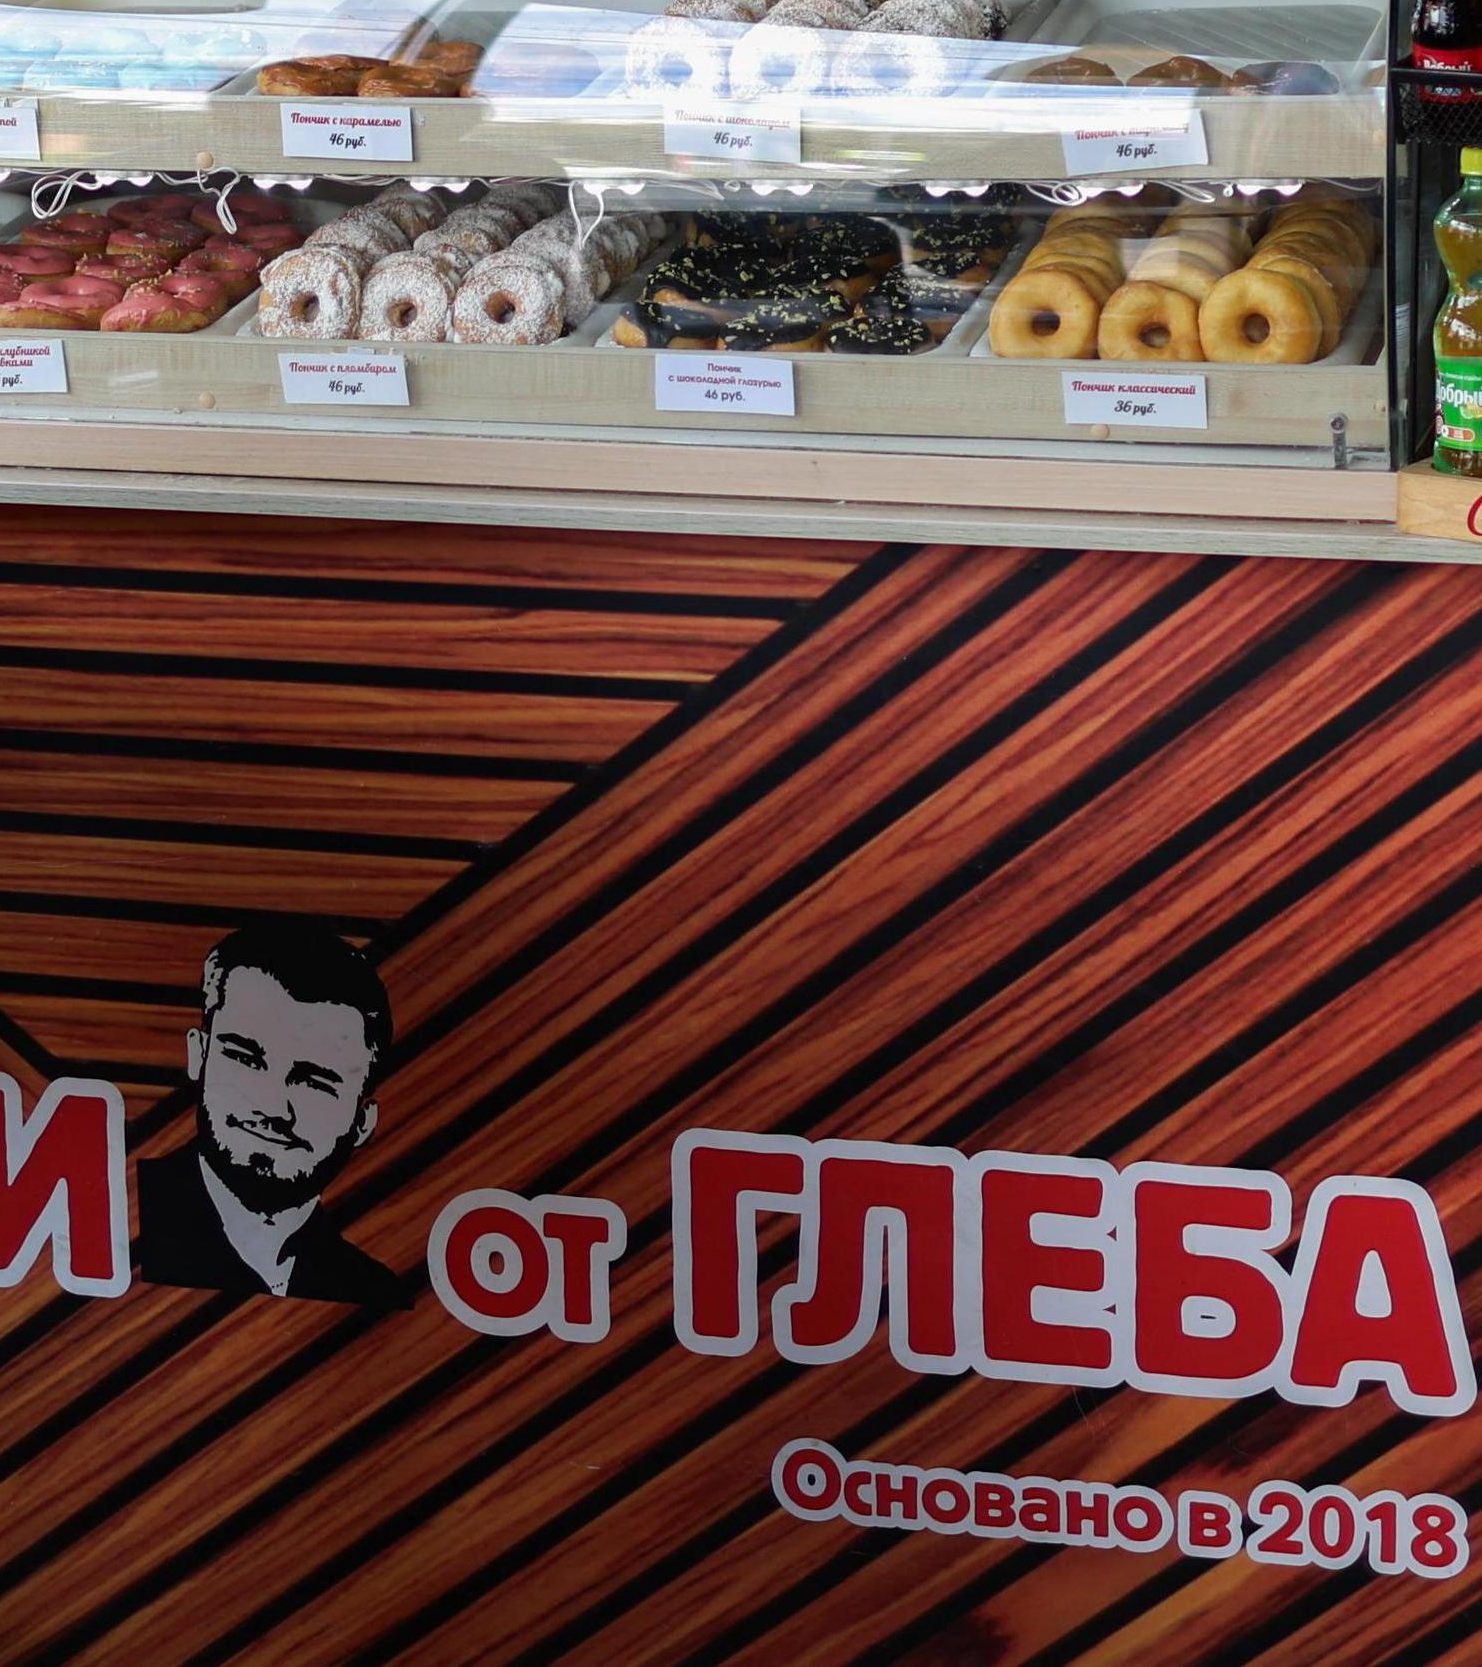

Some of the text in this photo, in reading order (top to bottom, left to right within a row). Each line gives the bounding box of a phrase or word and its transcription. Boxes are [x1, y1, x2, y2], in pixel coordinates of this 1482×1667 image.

[290, 112, 402, 129] Пончик с карамелью
[329, 132, 366, 149] 46 руб.
[713, 131, 753, 148] 46 руб.
[1116, 143, 1157, 158] 46 руб.
[288, 361, 397, 376] Пончик с пломбиром
[707, 362, 742, 374] Пончик
[1, 372, 23, 388] руб.
[328, 380, 366, 395] 46 руб.
[676, 373, 736, 386] шоколадной
[738, 377, 782, 389] глазурью
[1071, 380, 1197, 396] Пончик классический
[704, 389, 745, 403] 46 руб.
[1113, 400, 1157, 416] 36 руб.
[437, 1137, 1467, 1408] от ГЛЕБА
[777, 1442, 1463, 1573] Основано в 2018
